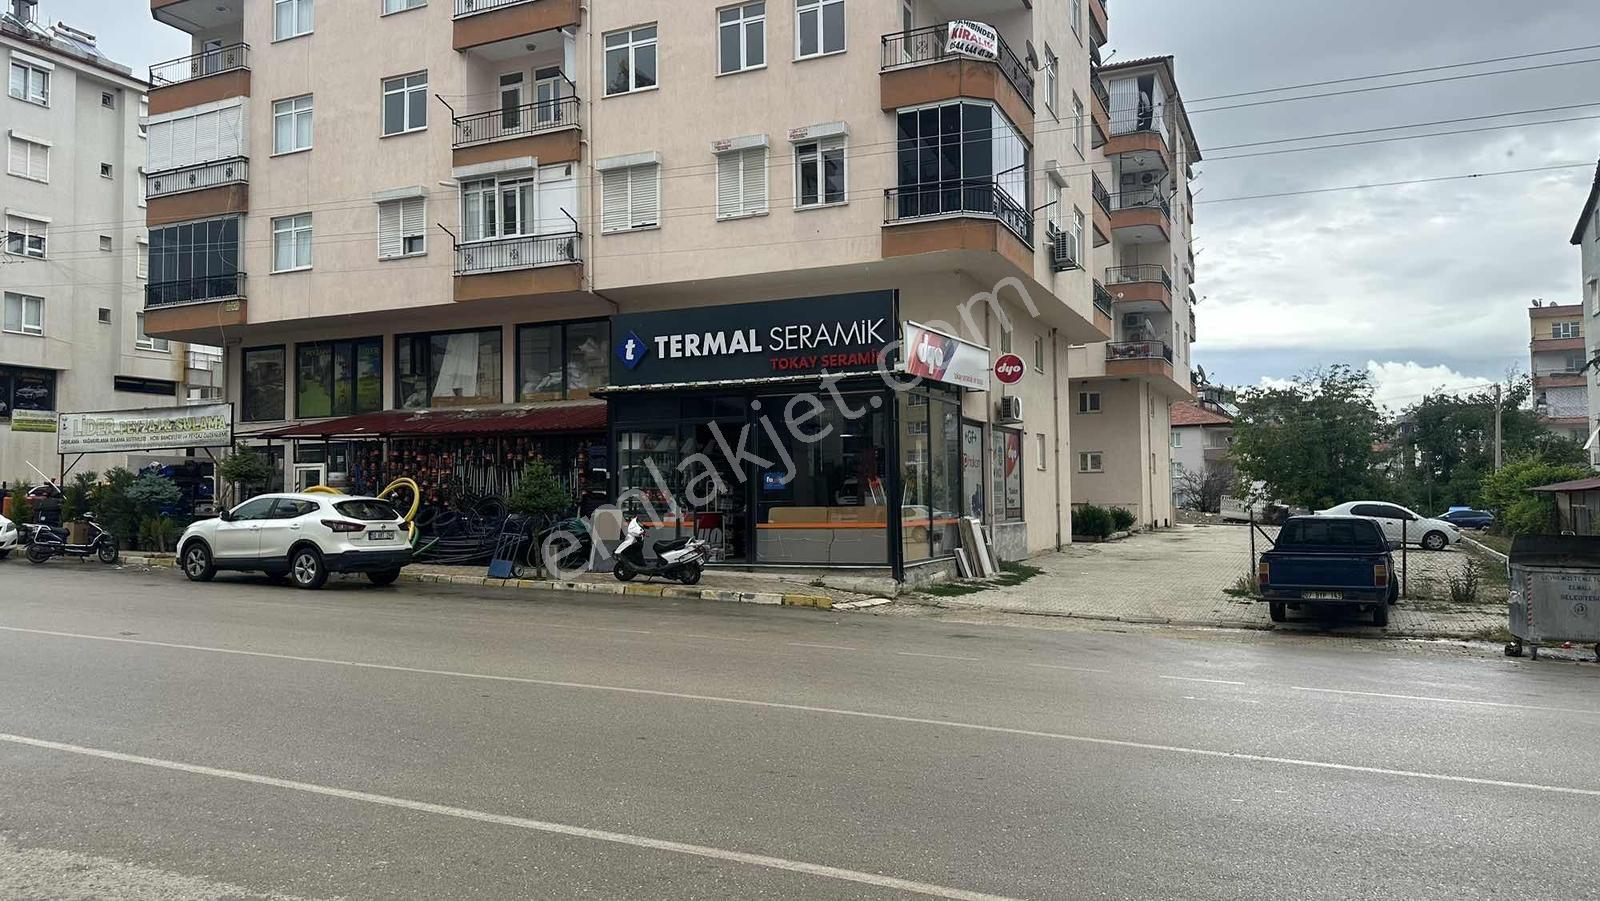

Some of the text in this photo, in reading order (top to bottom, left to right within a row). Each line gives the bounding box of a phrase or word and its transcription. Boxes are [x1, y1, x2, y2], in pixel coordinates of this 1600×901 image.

[654, 328, 762, 359] TERMAL
[769, 318, 885, 351] SERAMİK
[770, 355, 817, 370] TOKAY
[916, 333, 944, 375] dyo
[997, 362, 1021, 376] dyo
[73, 415, 116, 437] LİDER
[175, 415, 226, 432] SULAMA
